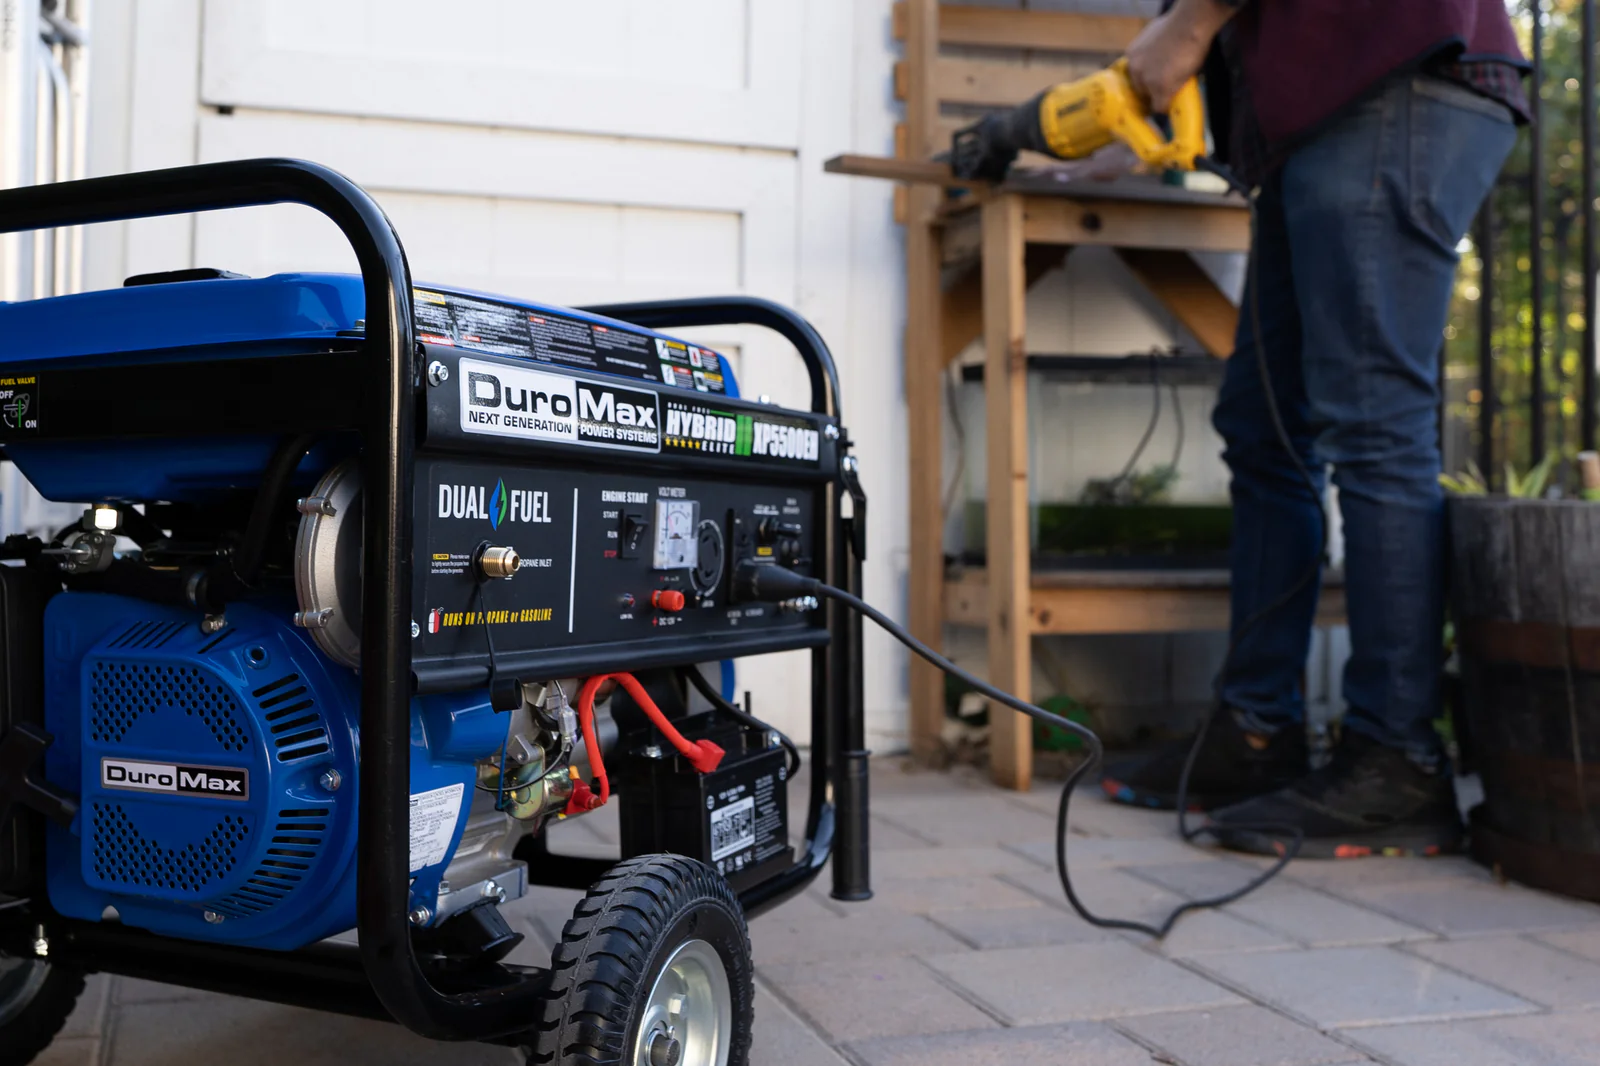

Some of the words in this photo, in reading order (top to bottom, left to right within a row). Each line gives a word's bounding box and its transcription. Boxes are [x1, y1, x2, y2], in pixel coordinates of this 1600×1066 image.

[0, 378, 16, 386] FUEL
[17, 376, 36, 385] VALVE
[0, 390, 14, 399] OFF
[467, 371, 657, 428] DuroMax
[25, 419, 37, 429] ON
[468, 410, 500, 426] NEXT
[503, 414, 572, 434] GENERATION
[666, 409, 736, 443] HYBRID
[580, 424, 614, 439] POWER
[616, 427, 658, 444] SYSTEMS
[701, 440, 735, 455] ELITE
[438, 483, 489, 519] DUAL
[510, 489, 551, 523] FUEL
[602, 490, 626, 502] ENGINE
[626, 491, 649, 504] START
[603, 510, 619, 519] START
[607, 530, 618, 539] RUN
[519, 558, 539, 568] ROPANE
[538, 558, 553, 568] INLET
[442, 613, 464, 627] RUNS
[464, 612, 475, 626] ON
[510, 612, 518, 623] or
[520, 608, 553, 623] GASOLINE
[106, 765, 242, 792] DuroMax
